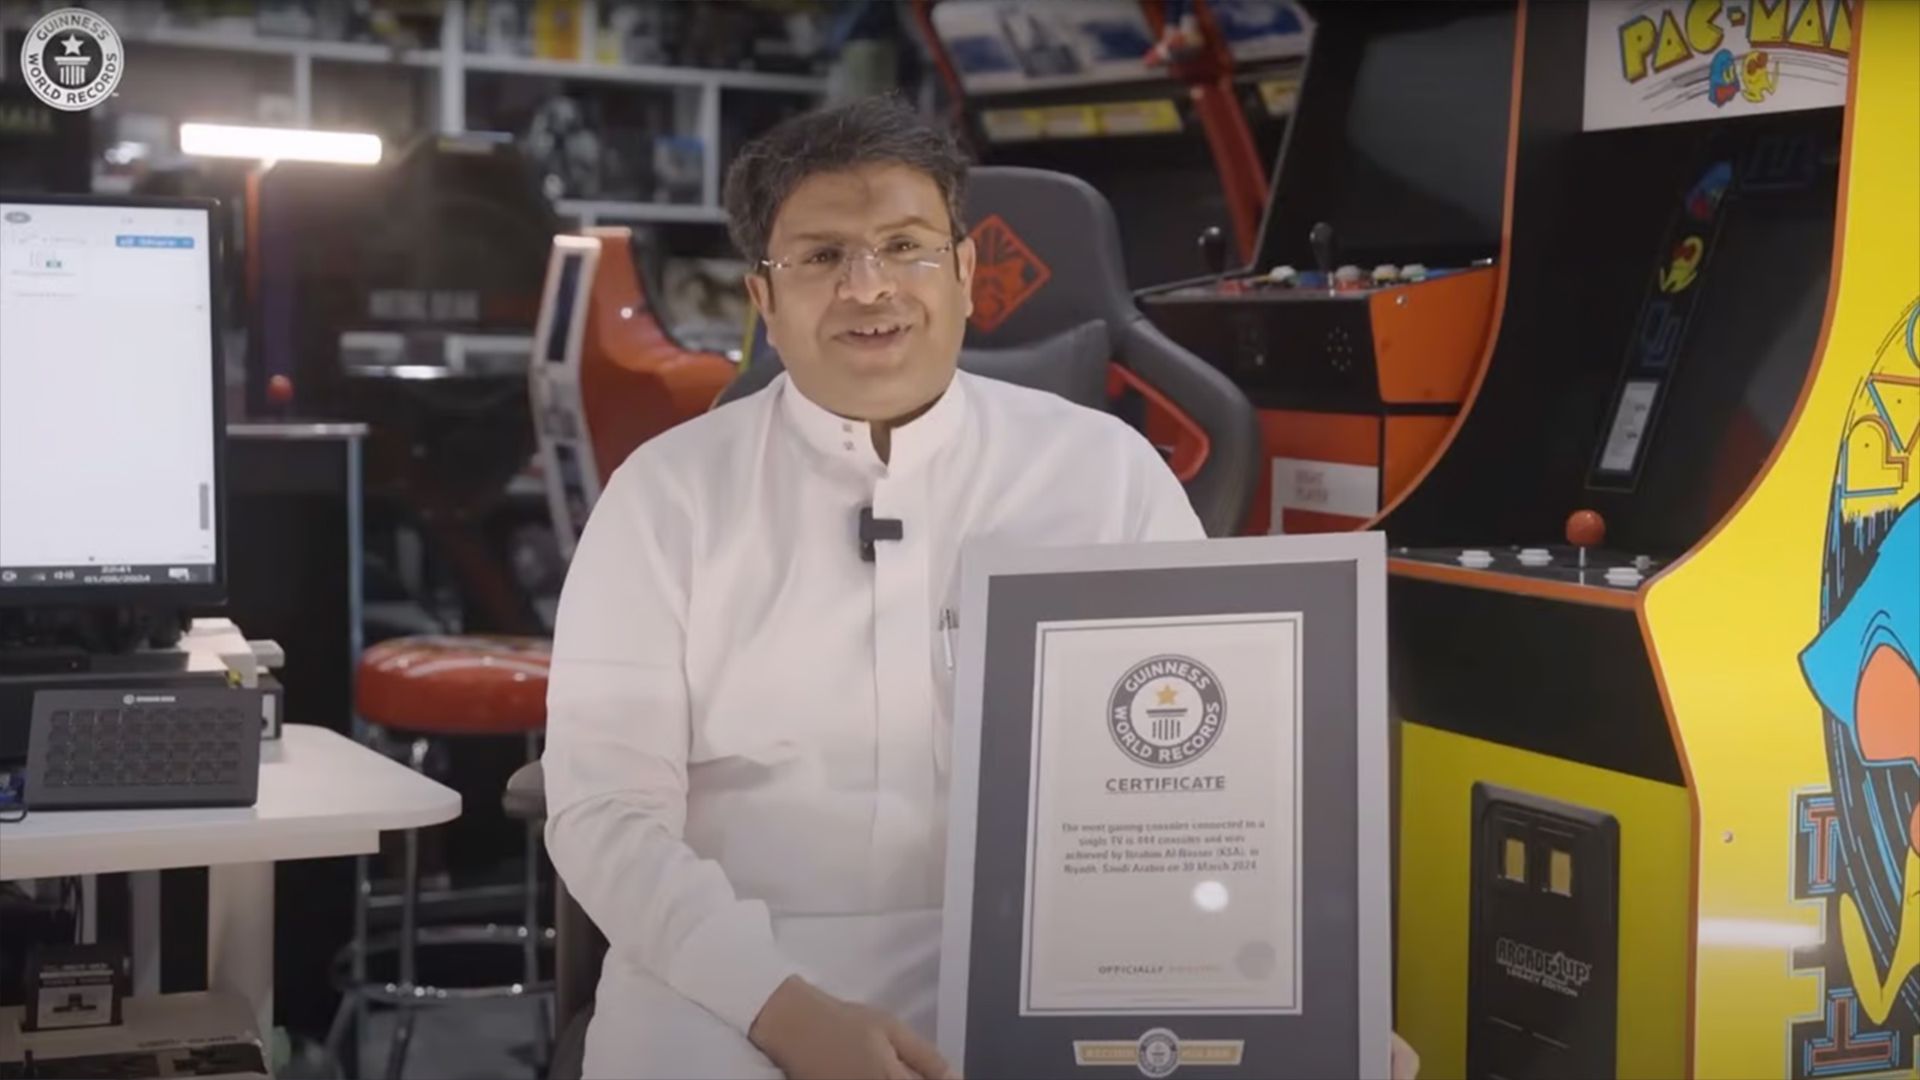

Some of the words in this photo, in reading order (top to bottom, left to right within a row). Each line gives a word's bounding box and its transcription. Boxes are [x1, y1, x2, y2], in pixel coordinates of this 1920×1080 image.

[1125, 661, 1211, 692] GUINNESS
[1114, 705, 1152, 758] WORLD
[1158, 701, 1220, 762] RECORDS
[1105, 775, 1226, 792] CERTIFICATE
[1081, 823, 1105, 832] most
[1107, 823, 1143, 834] gaming
[1191, 820, 1244, 831] connected
[1111, 836, 1124, 845] TV
[1065, 850, 1109, 860] achieved
[1111, 850, 1123, 861] by
[1102, 862, 1130, 873] Saudi
[1132, 863, 1165, 873] Arabia
[1197, 860, 1230, 872] March
[1098, 964, 1164, 975] OFFICIALLY
